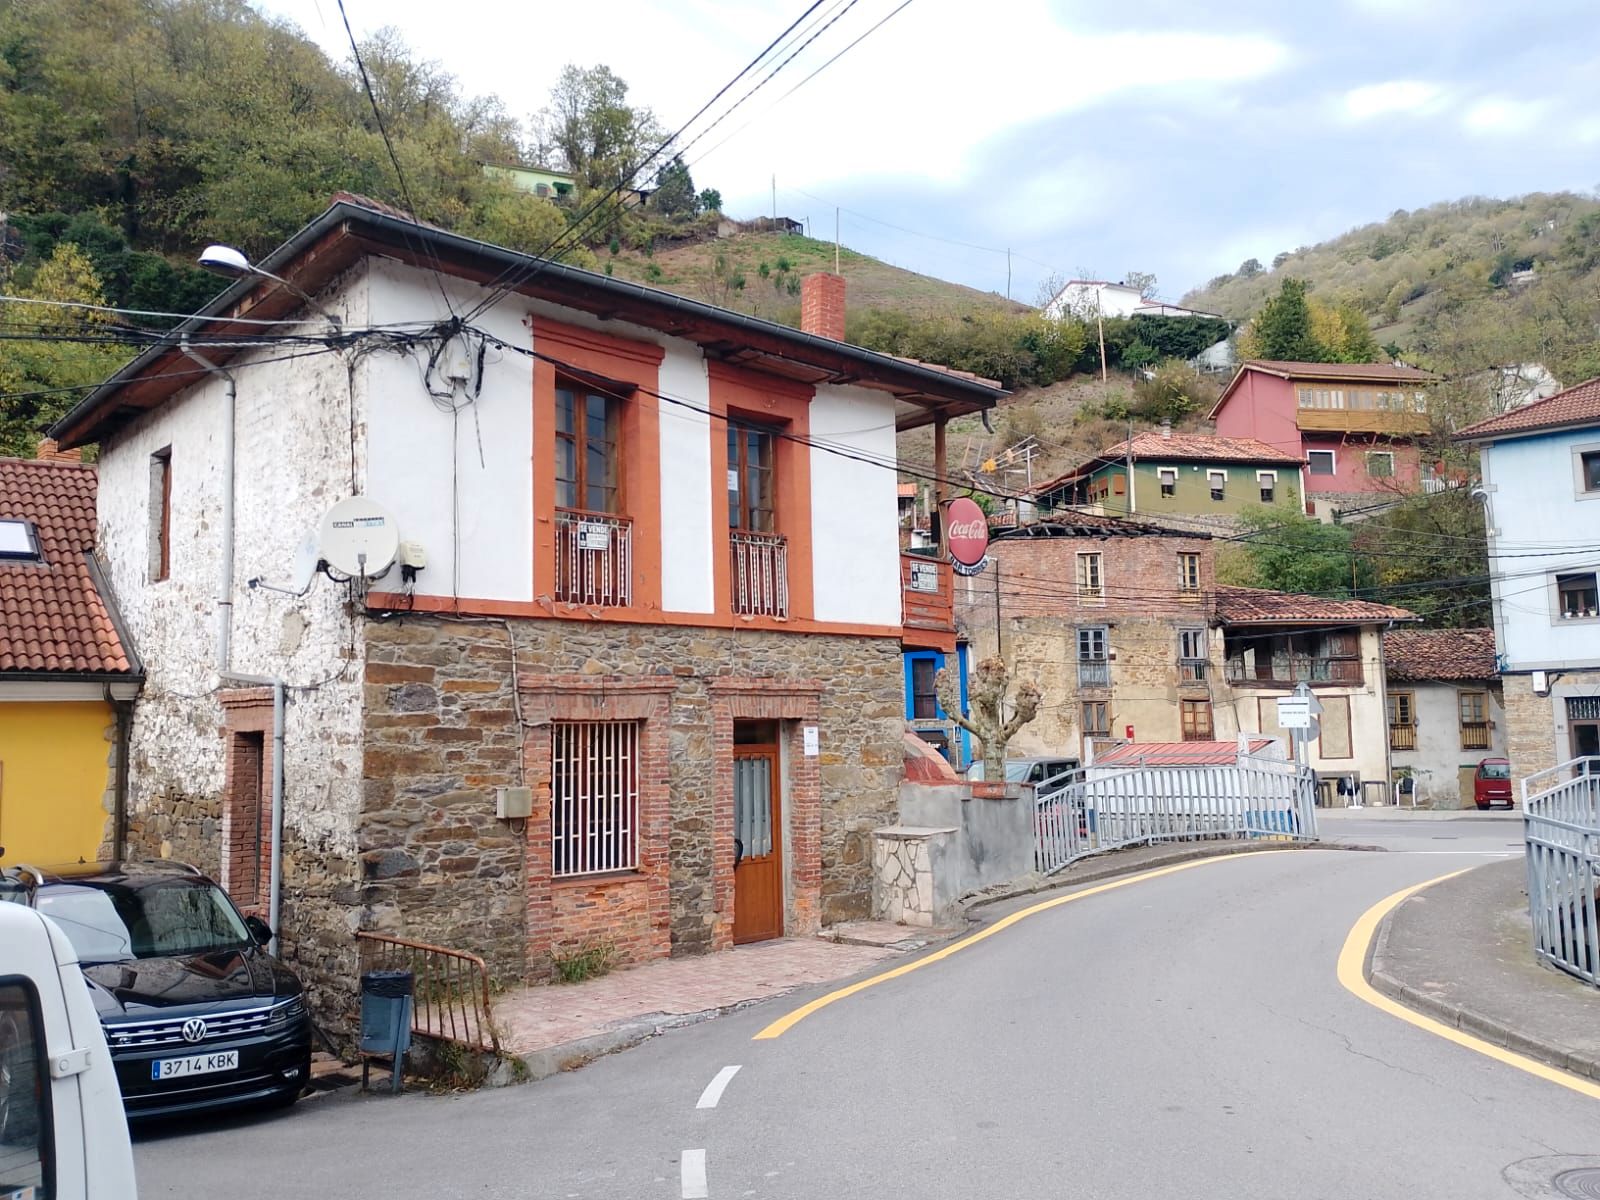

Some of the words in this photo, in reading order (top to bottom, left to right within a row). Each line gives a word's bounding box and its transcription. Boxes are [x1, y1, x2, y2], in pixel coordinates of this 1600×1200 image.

[588, 525, 609, 535] VENDE
[164, 1059, 202, 1075] 3714
[207, 1053, 235, 1071] KBK
